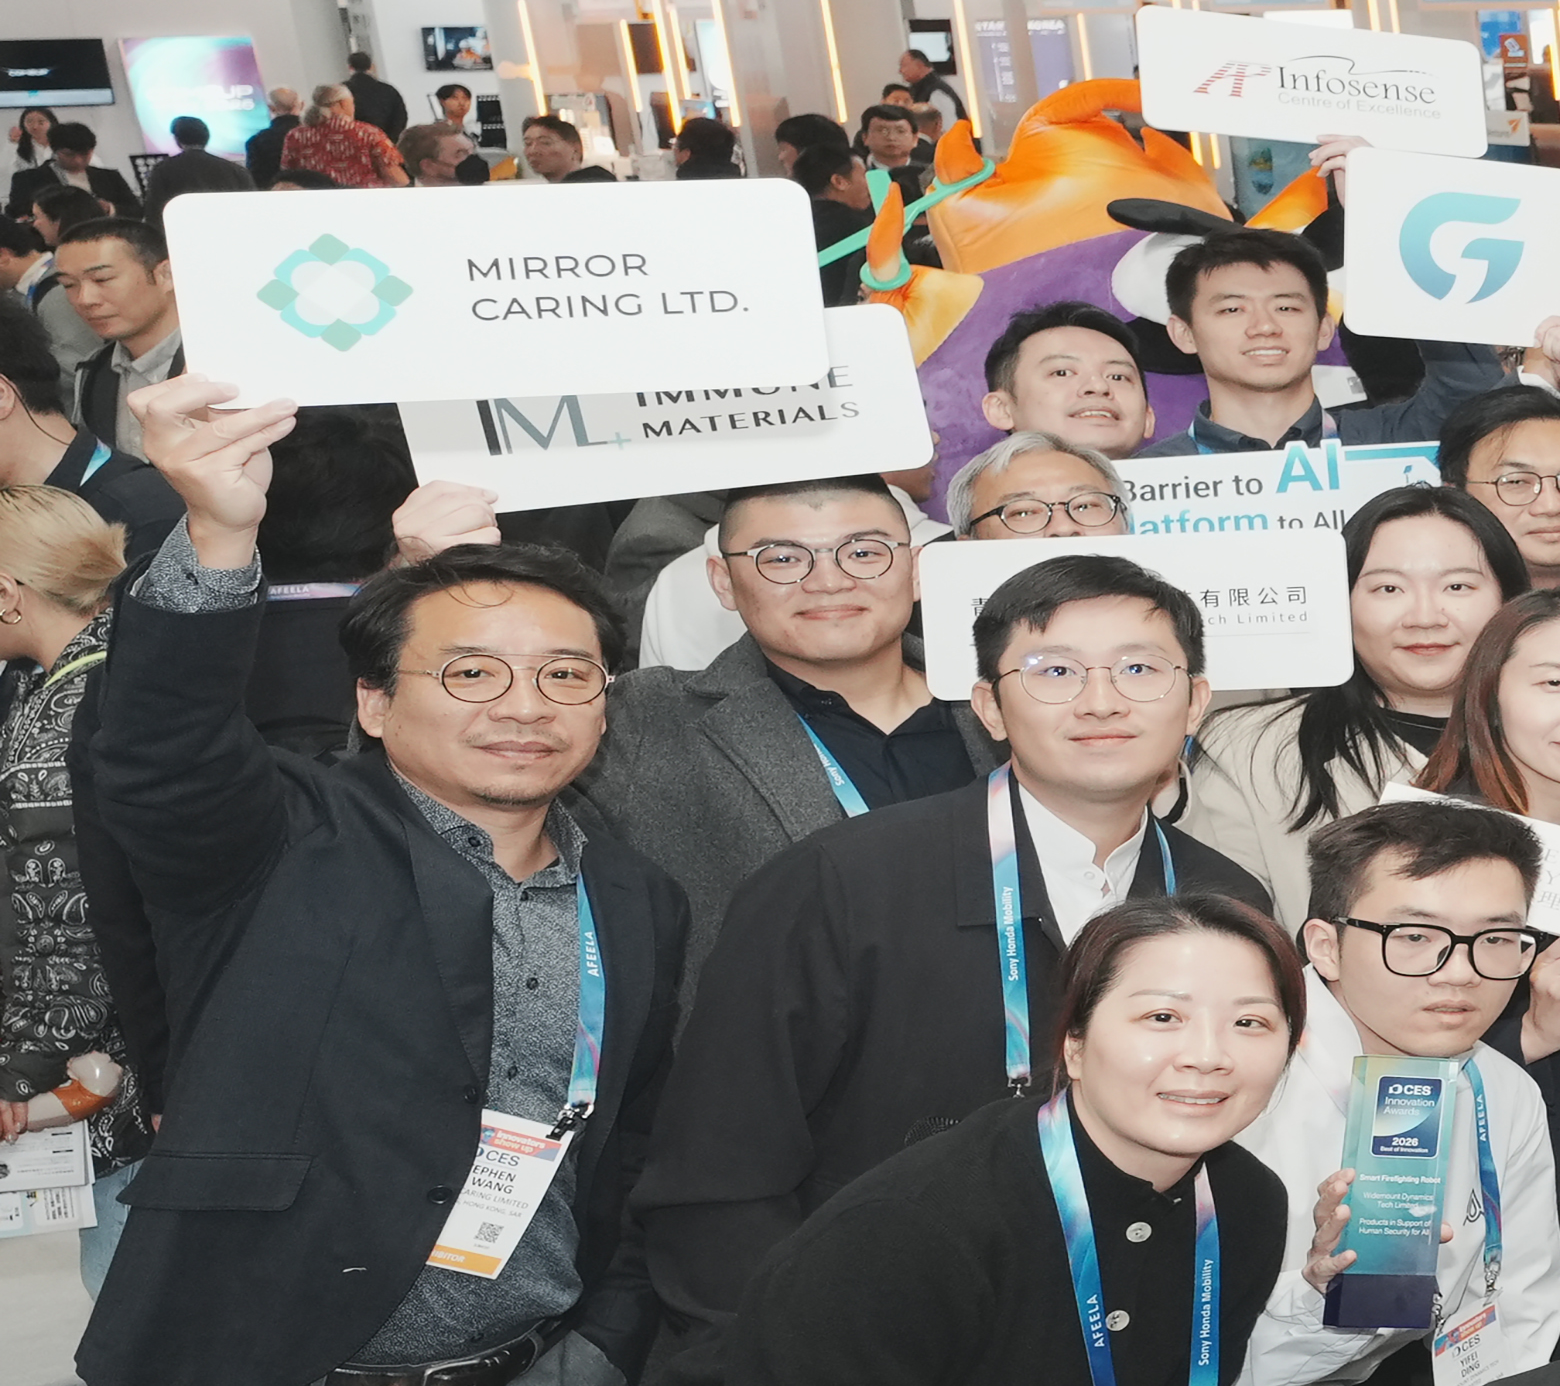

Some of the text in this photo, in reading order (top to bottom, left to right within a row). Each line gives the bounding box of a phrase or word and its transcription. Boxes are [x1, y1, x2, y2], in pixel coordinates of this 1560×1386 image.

[1277, 63, 1437, 104] Infosense
[1278, 90, 1442, 120] Centre of Excellence
[466, 253, 649, 282] MIRROR
[471, 288, 750, 322] CARING LTD.
[641, 401, 860, 441] MATERIALS
[1231, 472, 1263, 495] to
[1275, 439, 1342, 494] AI
[584, 931, 600, 978] AFEELA
[1384, 1096, 1435, 1107] Innovation
[1403, 1084, 1432, 1096] CES
[1383, 1106, 1421, 1116] Awards
[1391, 1137, 1419, 1147] 2026
[1360, 1173, 1380, 1182] Smart
[1420, 1175, 1441, 1184] Robot
[1198, 1258, 1214, 1366] Sony Honda Mobility
